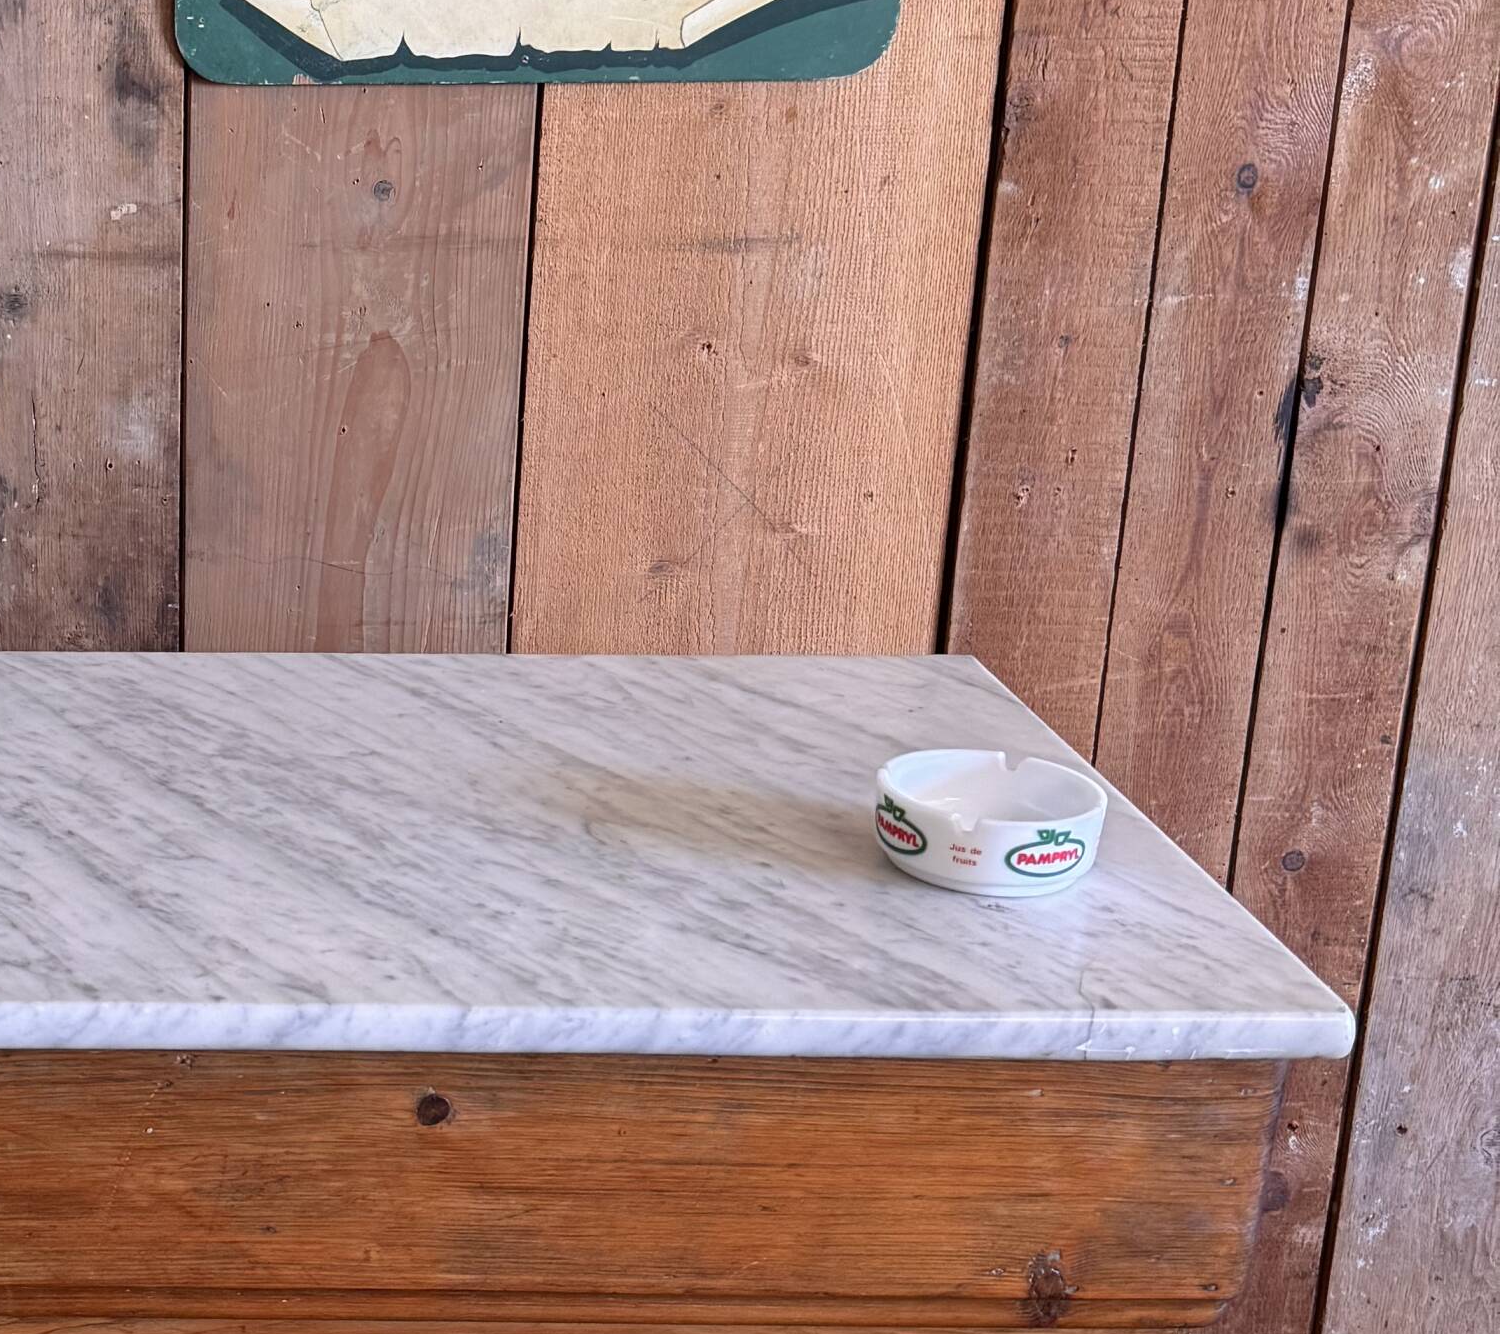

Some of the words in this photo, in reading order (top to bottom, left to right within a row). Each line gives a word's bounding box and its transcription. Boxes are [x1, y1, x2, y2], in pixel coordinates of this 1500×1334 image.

[949, 843, 966, 853] Jus
[970, 846, 982, 856] de
[952, 856, 977, 867] fruits
[1016, 848, 1080, 865] PAMPRYL
